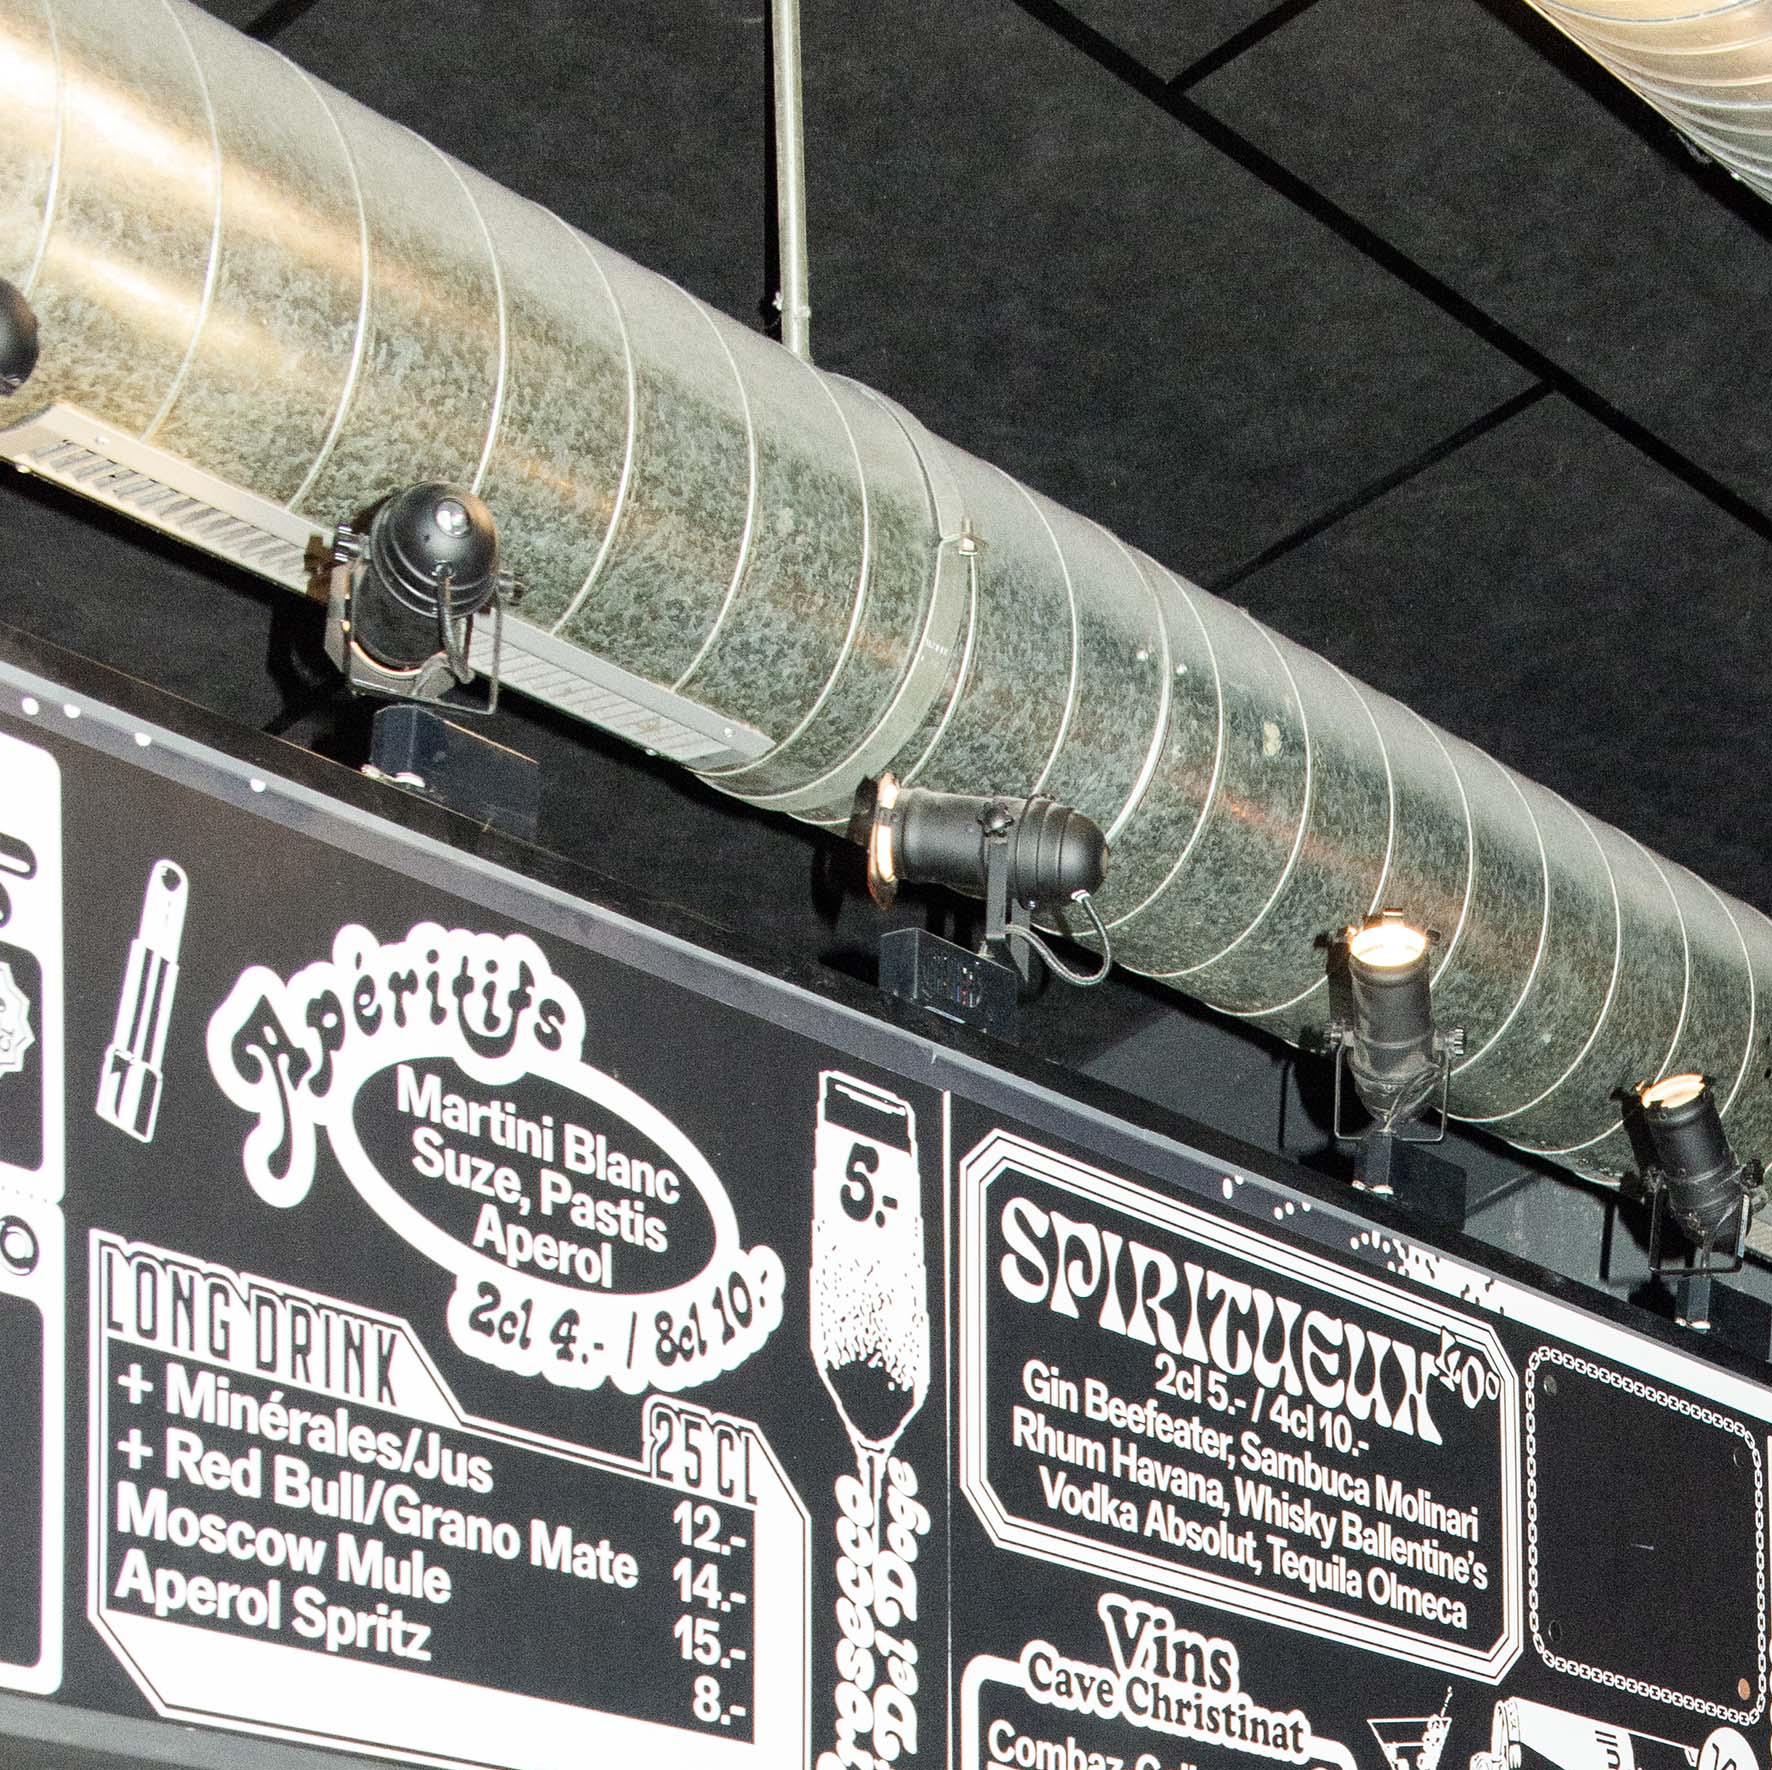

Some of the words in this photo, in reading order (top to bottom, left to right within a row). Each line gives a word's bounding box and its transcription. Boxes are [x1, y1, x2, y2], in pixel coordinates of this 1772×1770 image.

[229, 947, 567, 1182] Apéritifs
[398, 1063, 553, 1161] Martini
[565, 1125, 679, 1205] Blanc
[413, 1125, 531, 1213] Suze,
[541, 1170, 667, 1253] Pastis
[474, 1205, 613, 1288] Aperol
[106, 1246, 233, 1363] LONG
[255, 1286, 399, 1408] DRINK
[469, 1281, 533, 1351] 2cl
[654, 1310, 707, 1366] 8cl
[1000, 1196, 1443, 1446] SPIRITUEUX
[165, 1365, 493, 1494] Minérales/Jus
[650, 1409, 758, 1507] 25CL
[1022, 1360, 1078, 1415] Gin
[1084, 1379, 1234, 1472] Beefeater,
[1240, 1428, 1369, 1502] Sambuca
[1375, 1474, 1479, 1543] Molinari
[1155, 1352, 1201, 1403] 2cl
[1206, 1372, 1247, 1415] 5.-
[1270, 1393, 1316, 1446] 4cl
[1318, 1410, 1369, 1457] 10.-
[166, 1432, 261, 1499] Red
[274, 1455, 520, 1560] Bull/Grano
[530, 1519, 639, 1591] Mate
[875, 1458, 931, 1626] Doge
[1013, 1406, 1105, 1473] Rhum
[1111, 1435, 1229, 1513] Havana,
[1234, 1474, 1336, 1550] Whisky
[115, 1547, 282, 1632] Aperol
[292, 1585, 432, 1662] Spritz
[117, 1481, 327, 1576] Moscow
[337, 1532, 452, 1606] Mule
[1039, 1464, 1139, 1536] Vodka
[1144, 1497, 1262, 1577] Absolut,
[1266, 1534, 1363, 1600] Tequila
[1368, 1566, 1468, 1630] Olmeca
[874, 1634, 920, 1761] Del
[1027, 1649, 1113, 1711] Cave
[1125, 1678, 1305, 1755] Christinat
[1107, 1600, 1235, 1694] Vins
